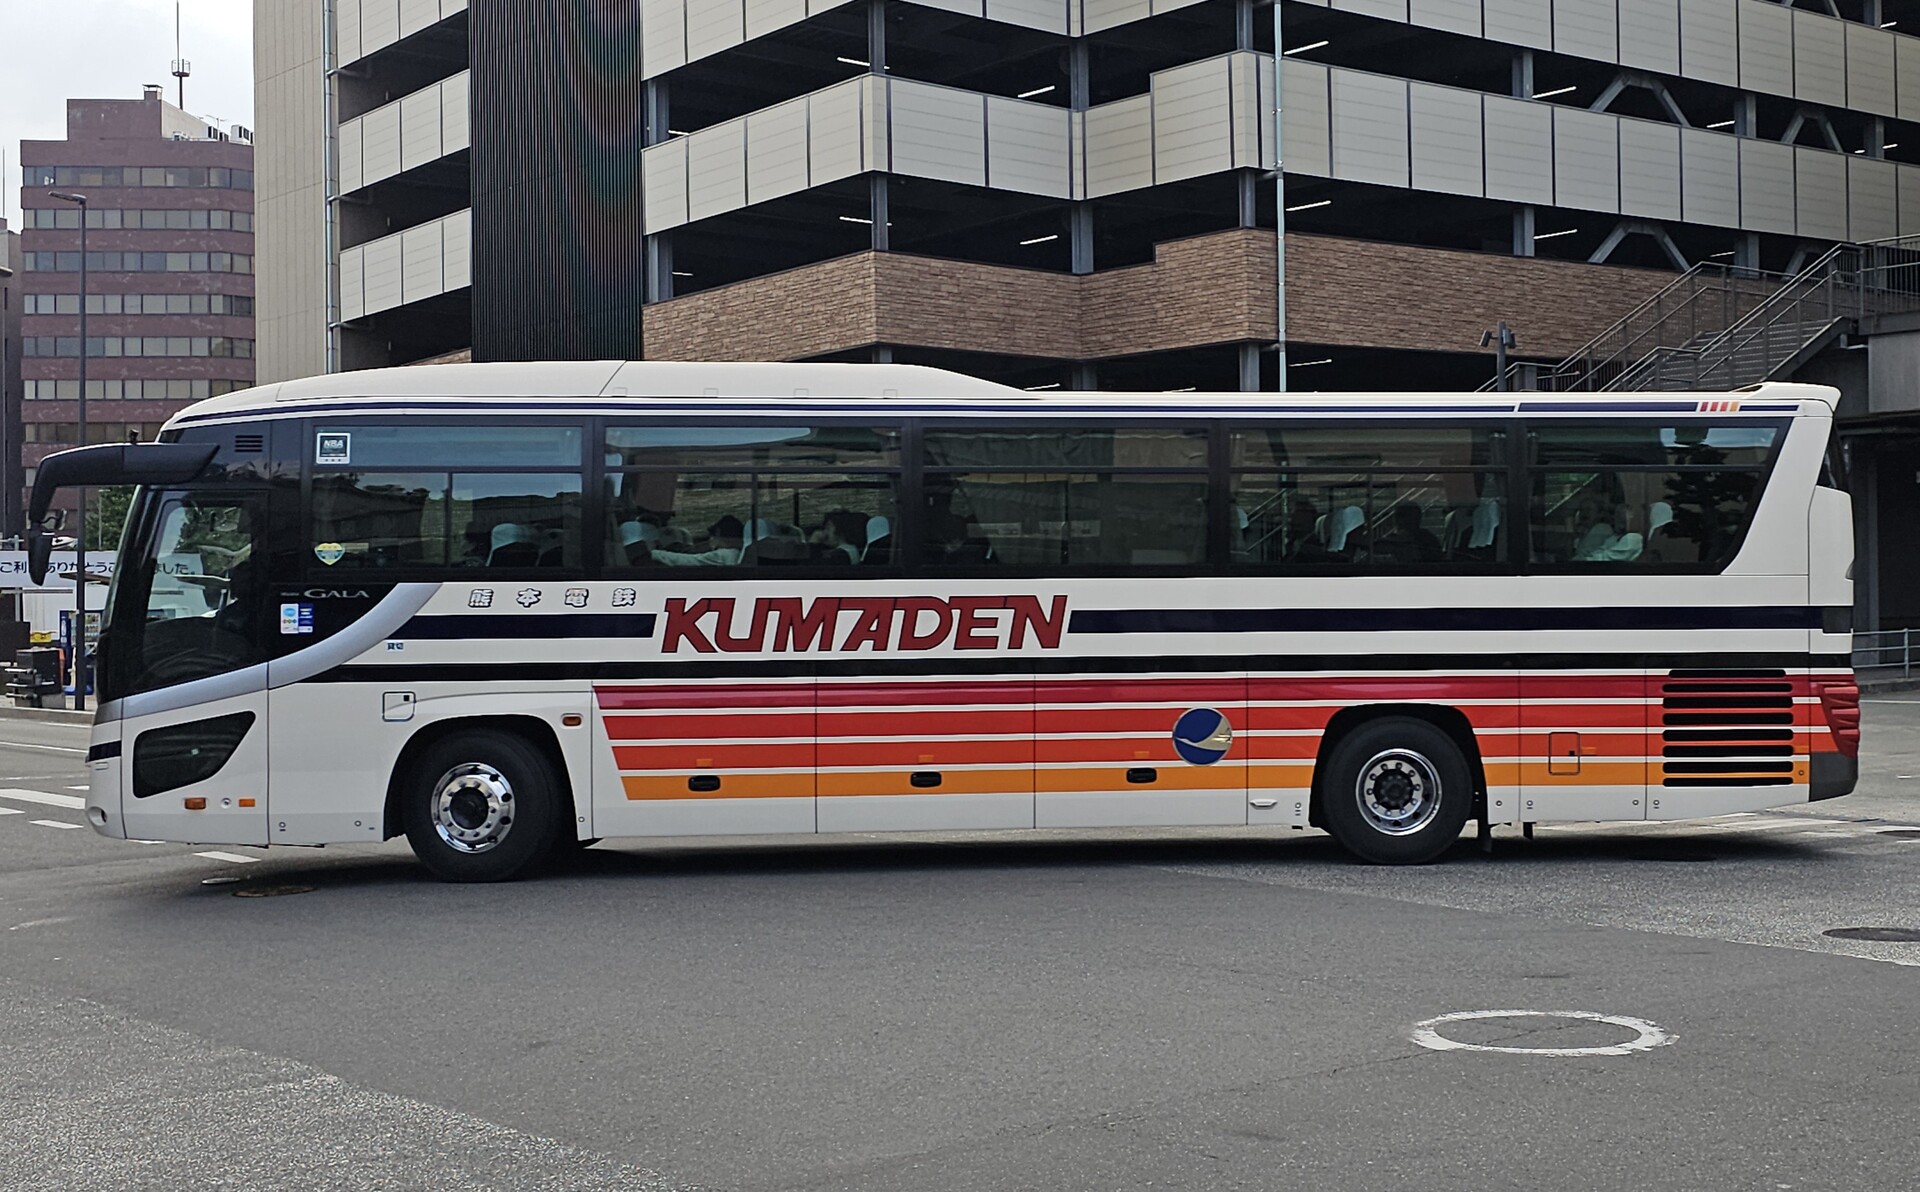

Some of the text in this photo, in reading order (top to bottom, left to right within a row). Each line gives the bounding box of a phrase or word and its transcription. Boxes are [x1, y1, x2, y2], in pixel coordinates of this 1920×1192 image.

[303, 588, 370, 599] GALA
[468, 587, 637, 608] 熊本電鉄
[661, 595, 1069, 653] KUMADEN
